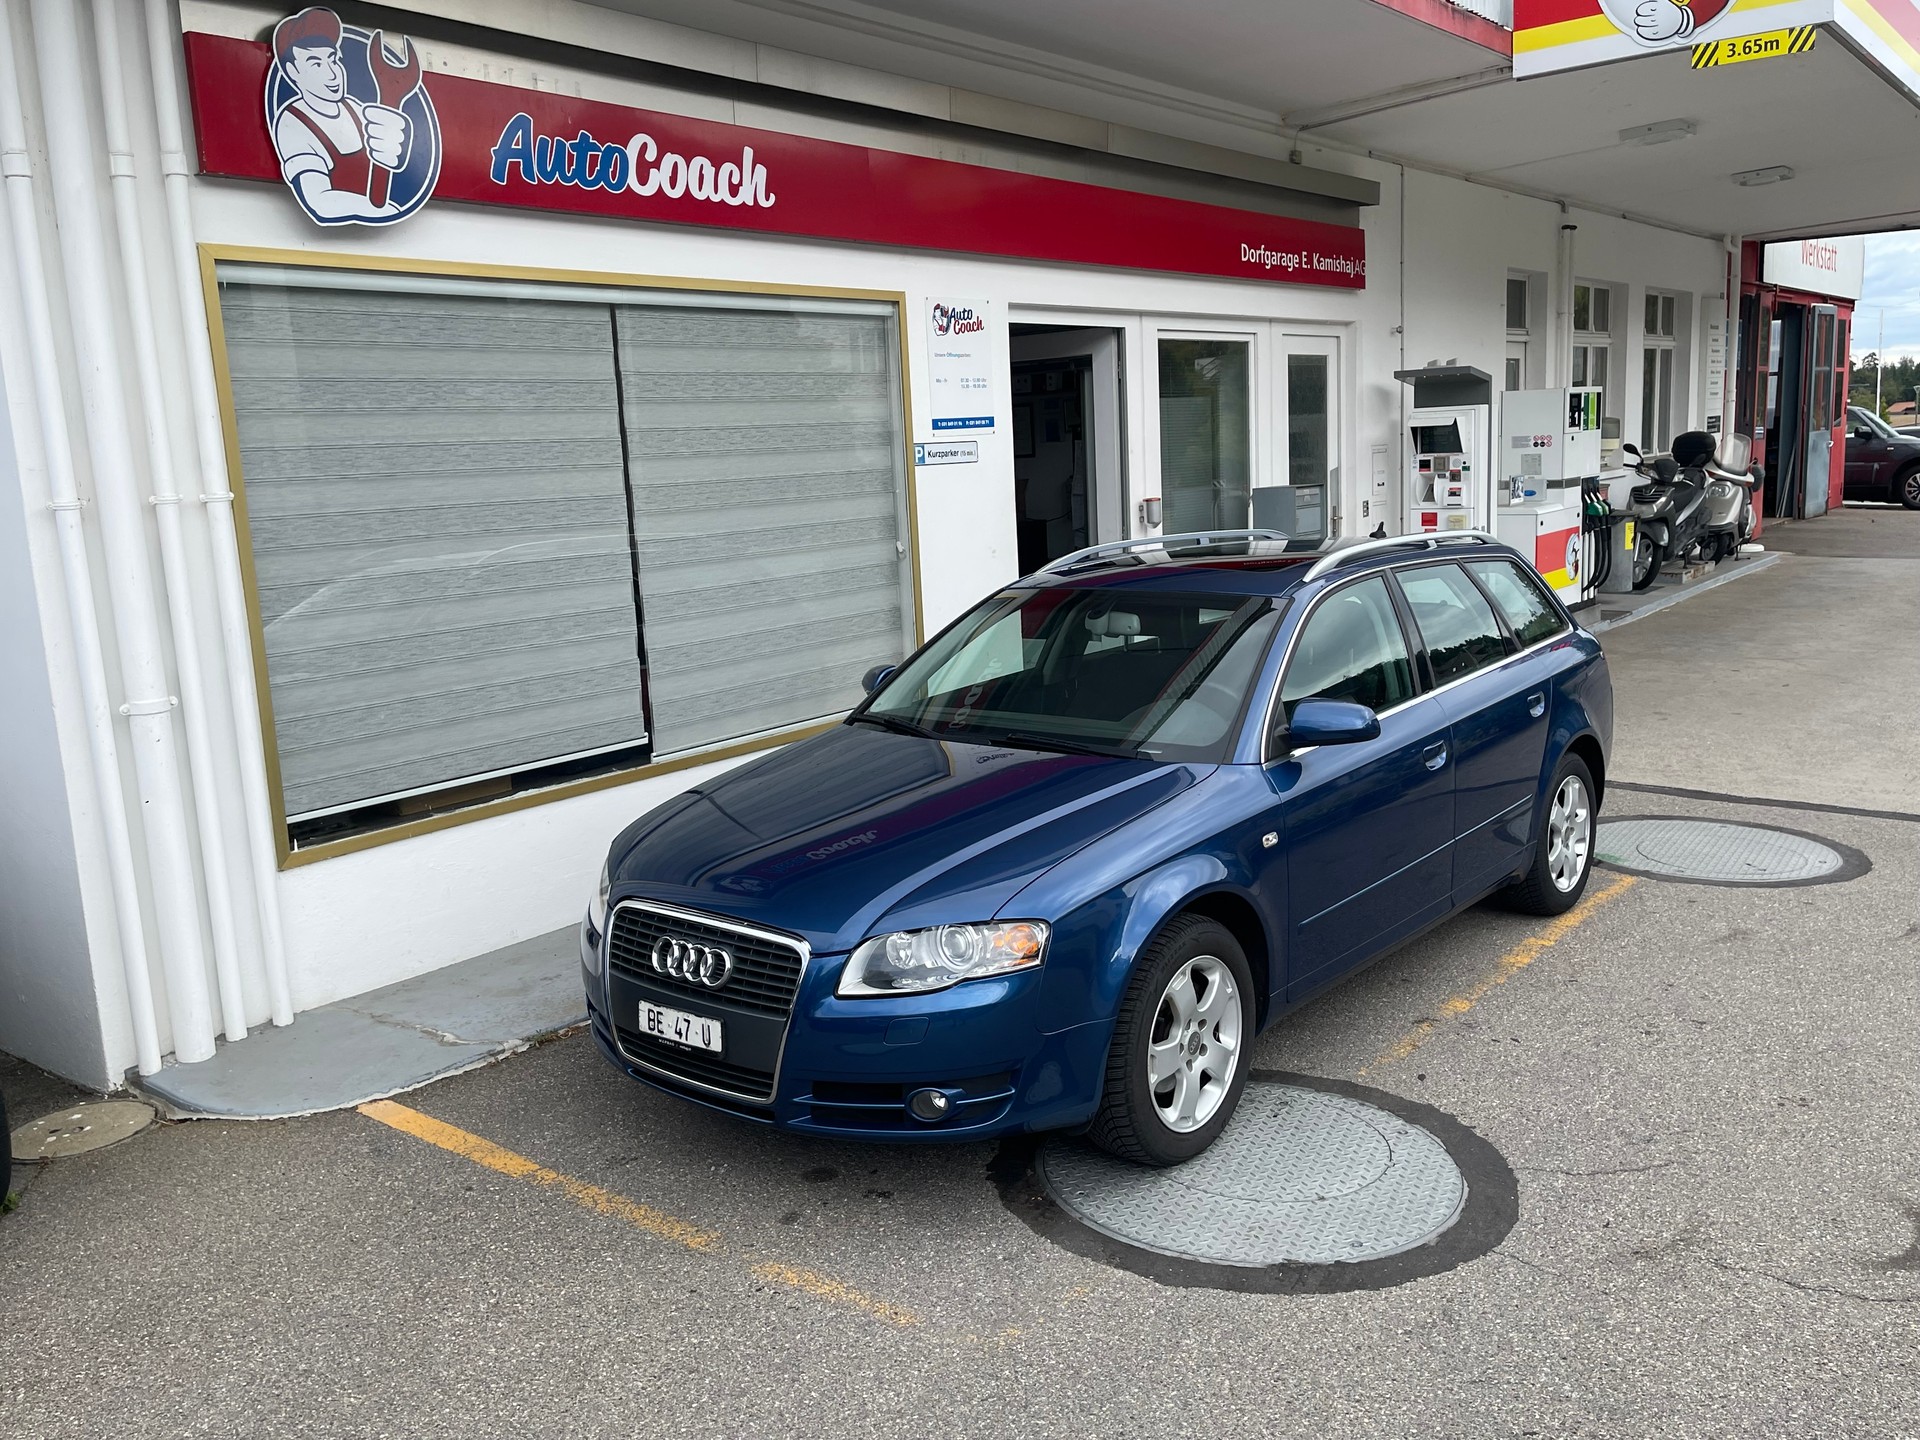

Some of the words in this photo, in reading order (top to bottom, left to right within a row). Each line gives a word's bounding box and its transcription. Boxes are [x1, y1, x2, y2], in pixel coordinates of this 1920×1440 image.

[1727, 38, 1780, 58] 3.65m
[1241, 243, 1299, 272] Dorfgarage
[1302, 251, 1311, 269] E.
[1313, 252, 1354, 278] Kamishaj
[1801, 239, 1837, 272] Werkstatt
[949, 307, 973, 323] Auto
[953, 315, 985, 335] Coach
[914, 446, 924, 463] P
[927, 449, 960, 459] Kurzparker
[647, 1008, 665, 1035] BE
[674, 1016, 691, 1042] 47
[701, 1023, 712, 1048] U
